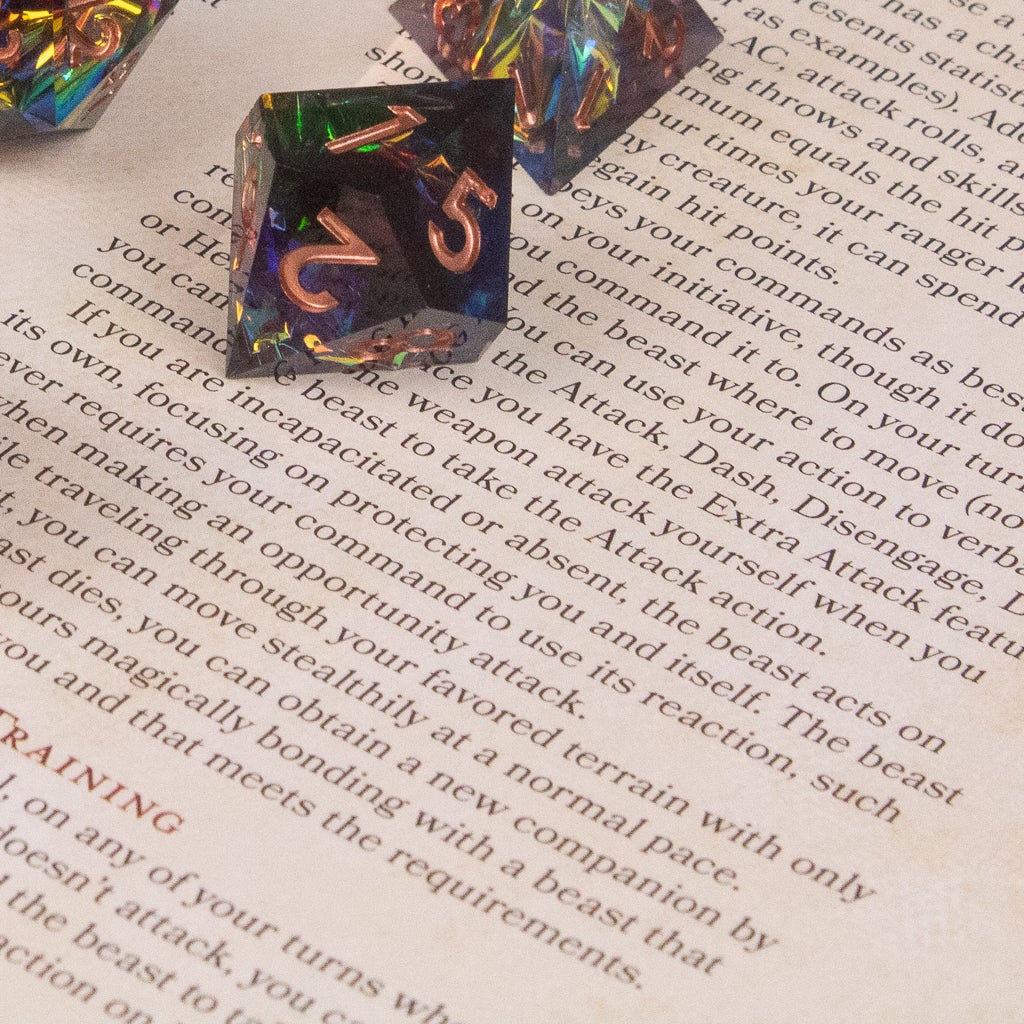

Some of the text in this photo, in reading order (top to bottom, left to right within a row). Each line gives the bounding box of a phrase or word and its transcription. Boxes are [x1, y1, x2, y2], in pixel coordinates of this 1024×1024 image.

[428, 167, 498, 274] 5
[730, 35, 986, 164] AC, attack rolls,
[67, 299, 947, 755] If you are incapacitated or absent, the beast acts on
[407, 392, 987, 684] weapon attack yourself when you
[491, 350, 987, 602] the Attack, Dash, Disengage,
[22, 797, 71, 830] on
[74, 826, 146, 869] any
[147, 866, 200, 893] of
[181, 887, 279, 939] your
[324, 626, 876, 903] your favored terrain with only
